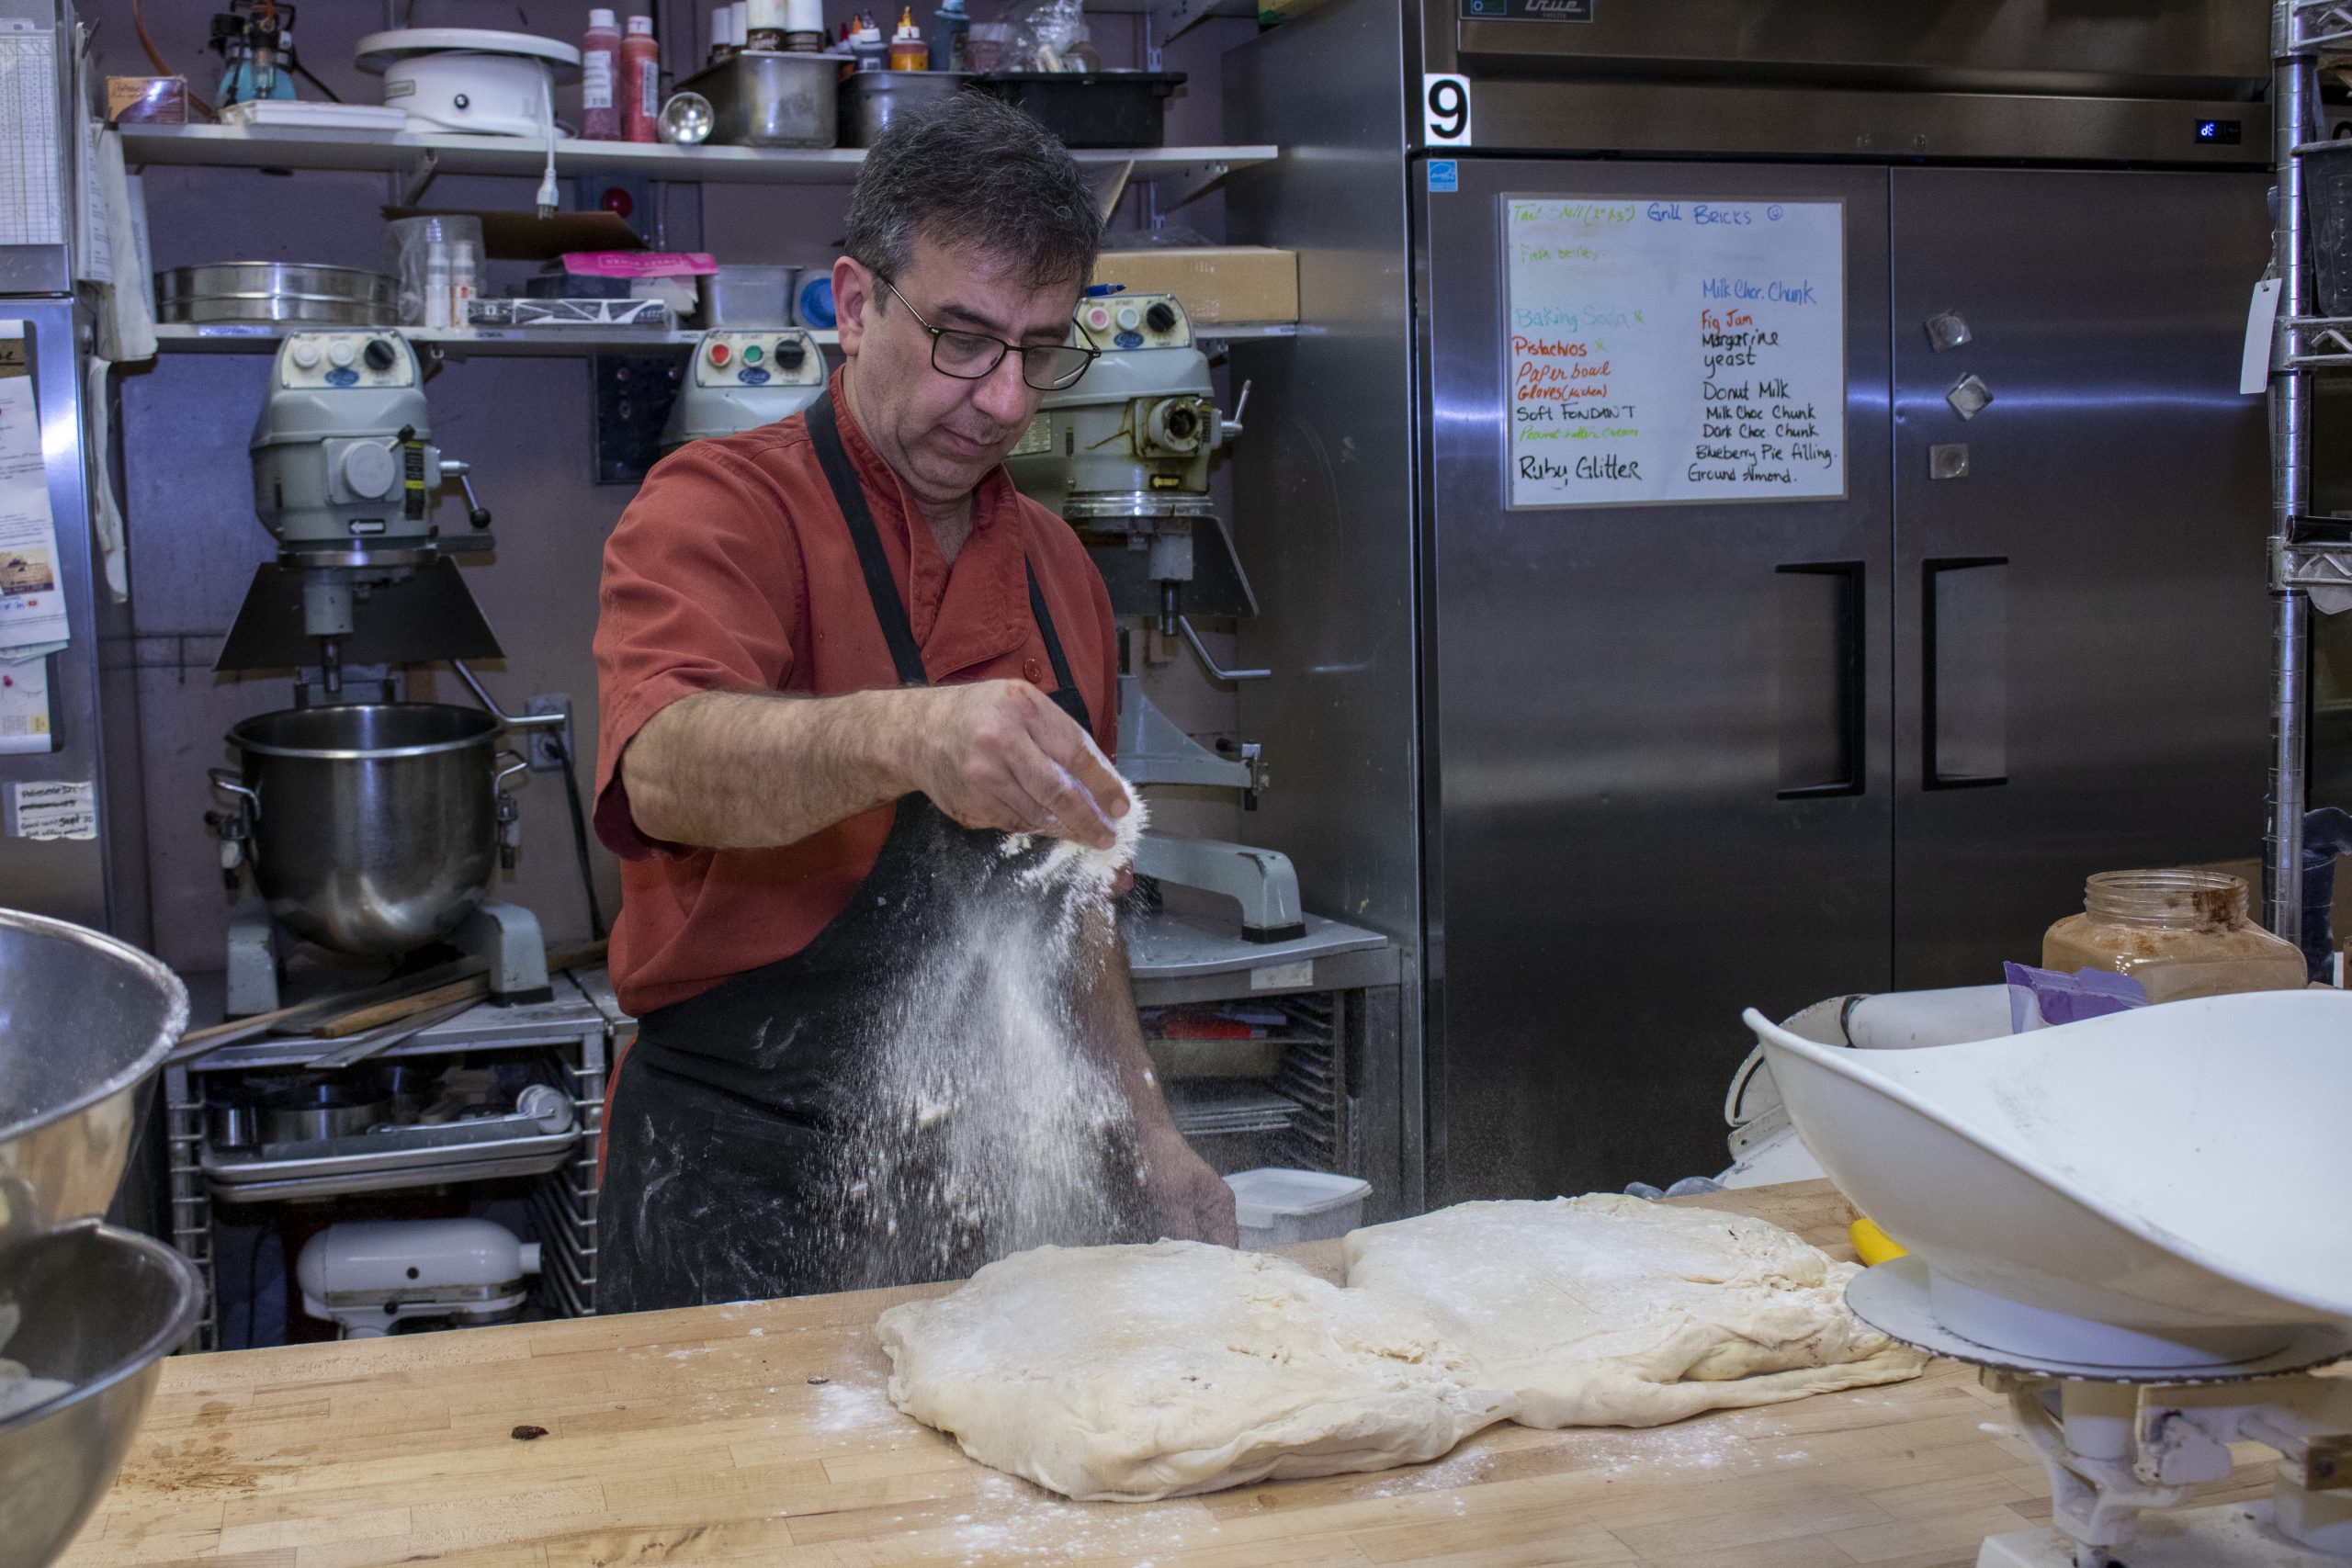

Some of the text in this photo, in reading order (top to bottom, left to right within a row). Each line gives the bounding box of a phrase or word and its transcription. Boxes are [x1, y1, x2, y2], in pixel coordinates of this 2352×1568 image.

[1429, 79, 1468, 139] 9
[1647, 203, 1681, 221] Grill
[1702, 279, 1732, 299] Milk
[1768, 280, 1817, 305] Chunk
[1702, 309, 1752, 333] Fig Jam
[1702, 329, 1779, 351] Margarine
[1703, 378, 1791, 400] Donut Milk
[1517, 405, 1553, 422] Soft
[1707, 402, 1816, 420] Milk Choc Chunk
[1703, 423, 1732, 438] Dark
[1775, 423, 1819, 438] Chunk
[1696, 445, 1758, 467] Blueberry
[1761, 444, 1783, 460] Pie
[1688, 463, 1736, 482] Ground
